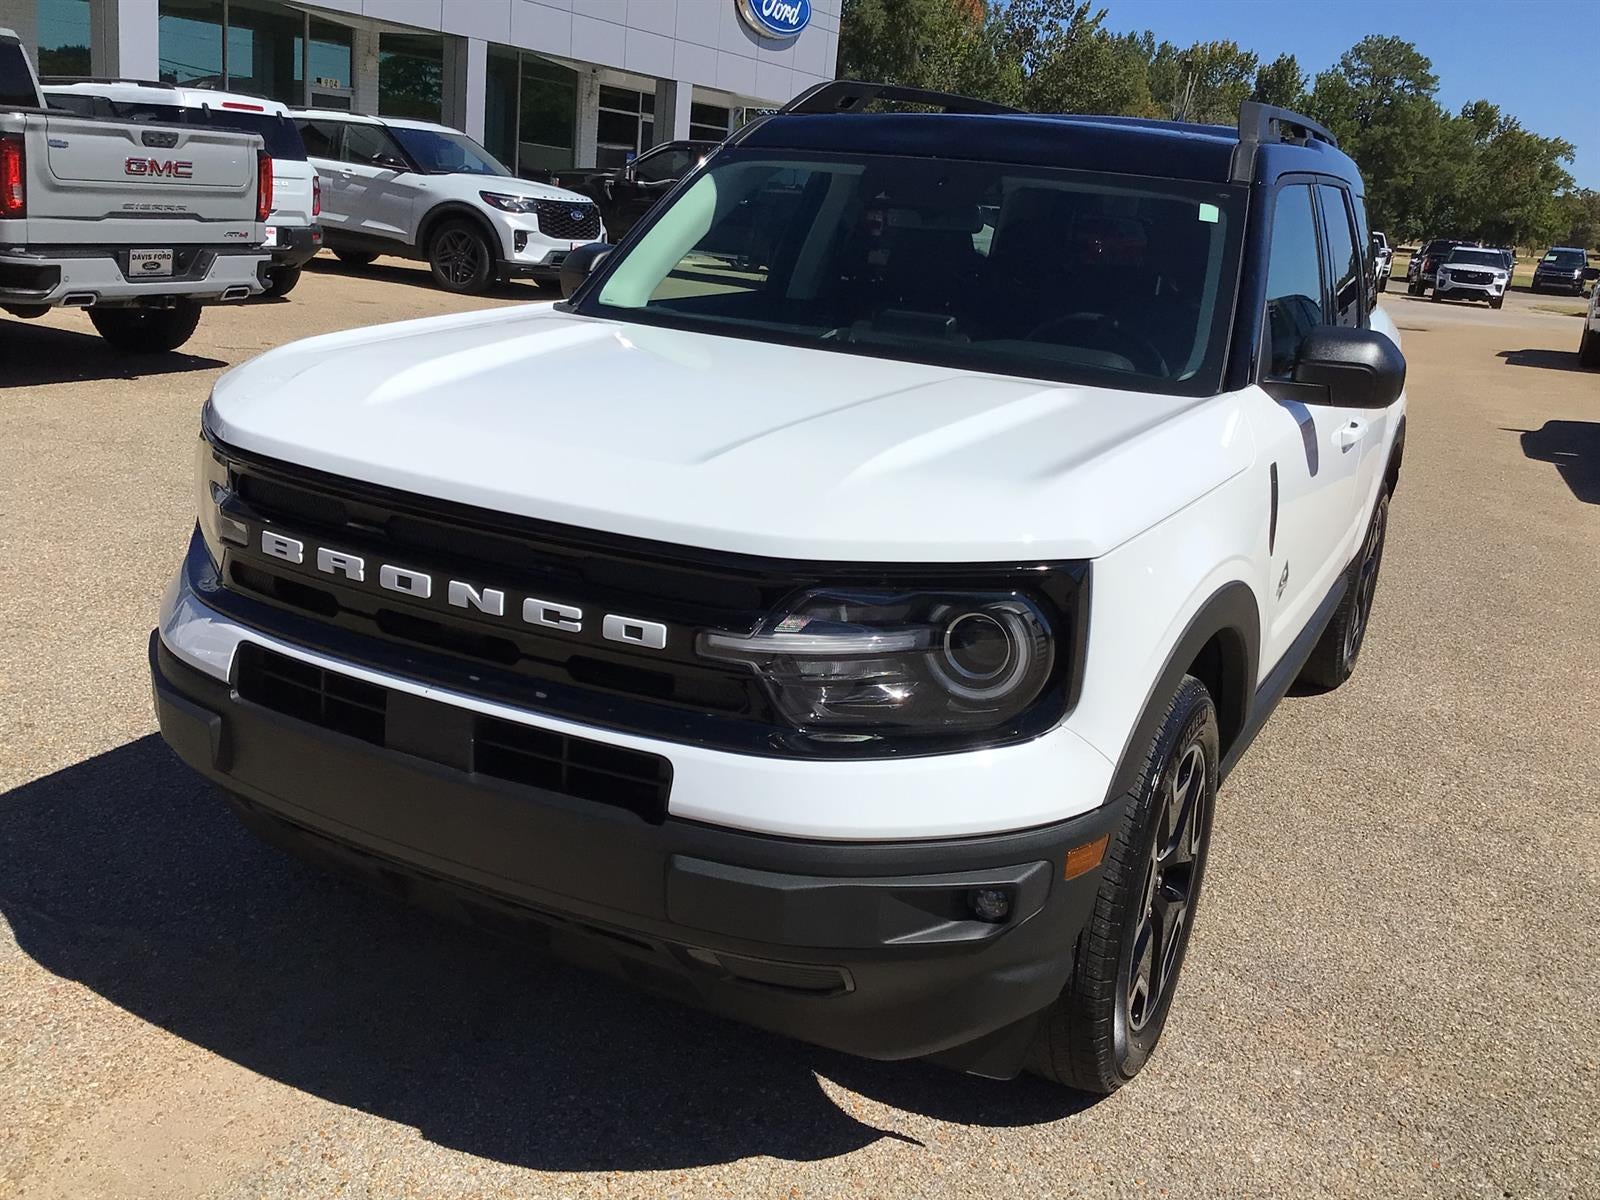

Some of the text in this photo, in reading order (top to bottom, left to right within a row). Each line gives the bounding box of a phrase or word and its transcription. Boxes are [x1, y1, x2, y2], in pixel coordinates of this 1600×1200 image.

[762, 0, 801, 26] Ford
[125, 157, 193, 179] GMC
[262, 530, 667, 649] BRONCO
